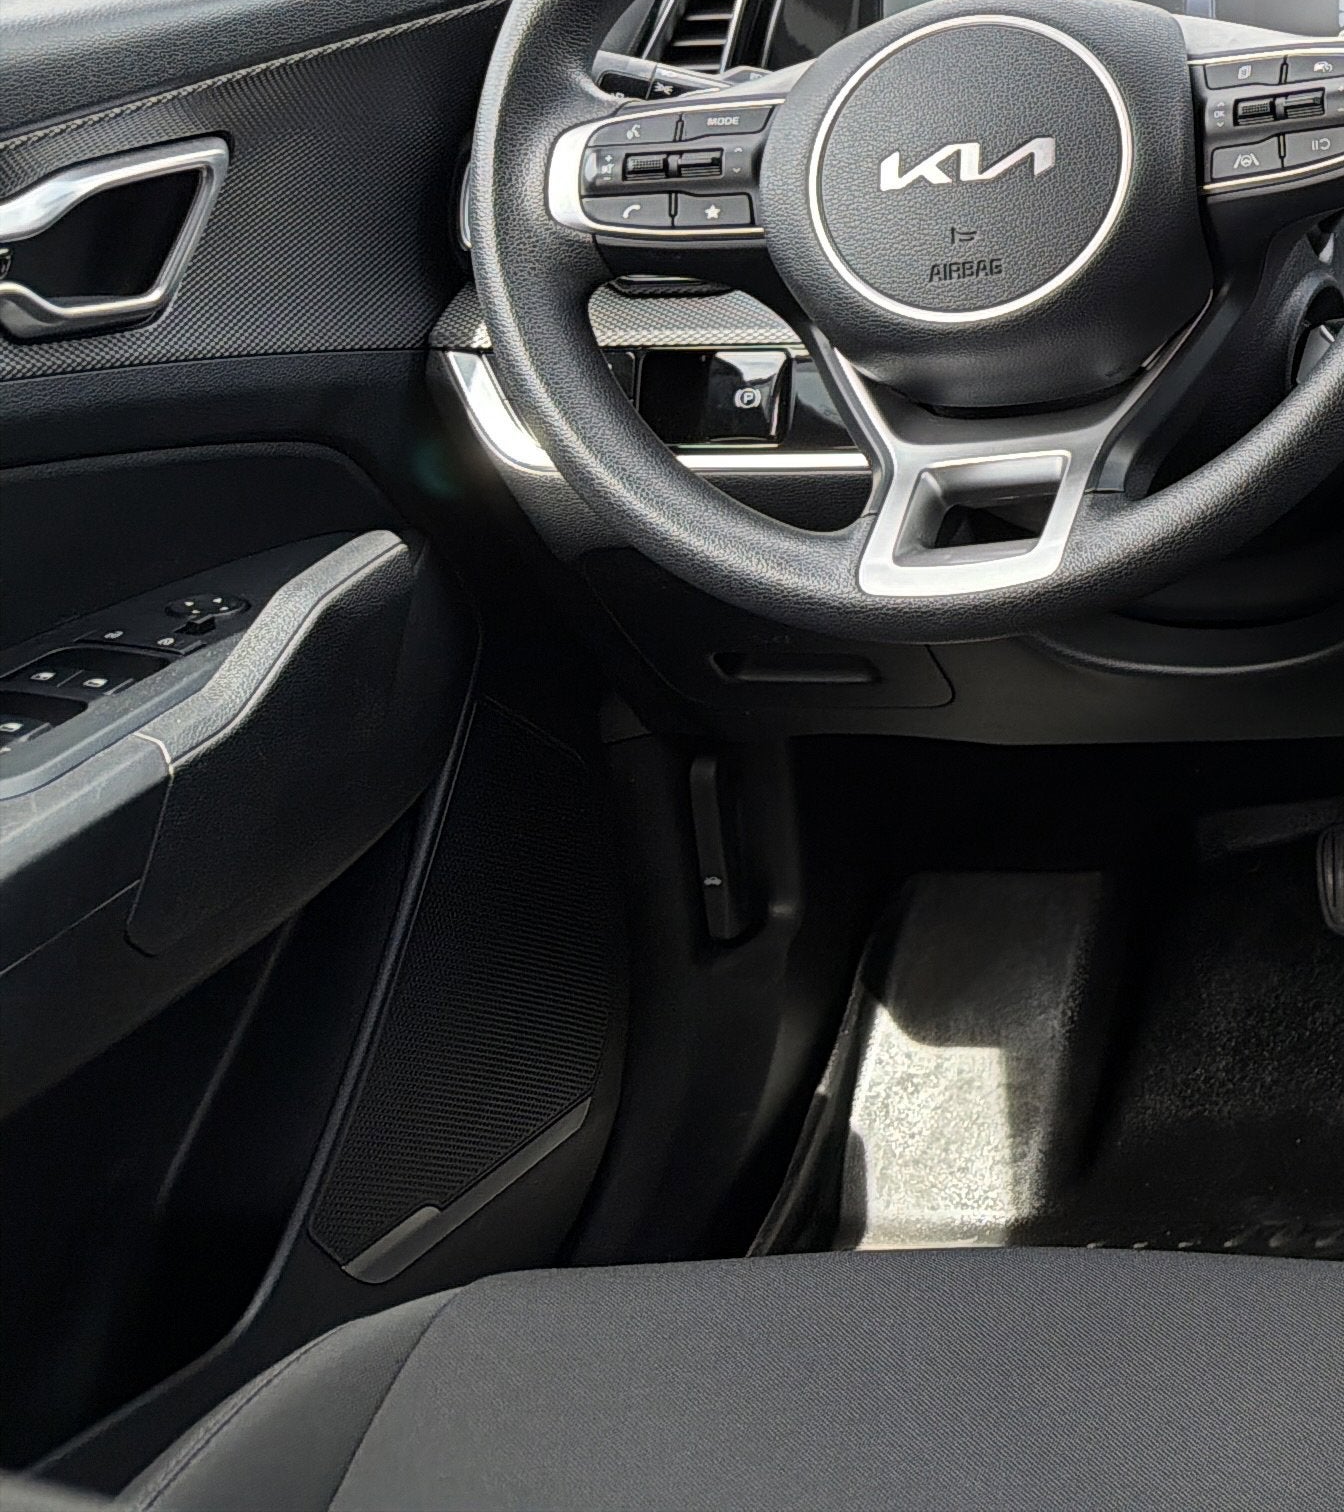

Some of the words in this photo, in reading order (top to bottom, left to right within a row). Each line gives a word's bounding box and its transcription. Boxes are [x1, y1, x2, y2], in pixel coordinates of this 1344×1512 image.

[707, 116, 740, 126] MODE
[1213, 110, 1225, 118] OK
[879, 137, 1056, 191] KIA
[928, 257, 1003, 283] AIRBAG
